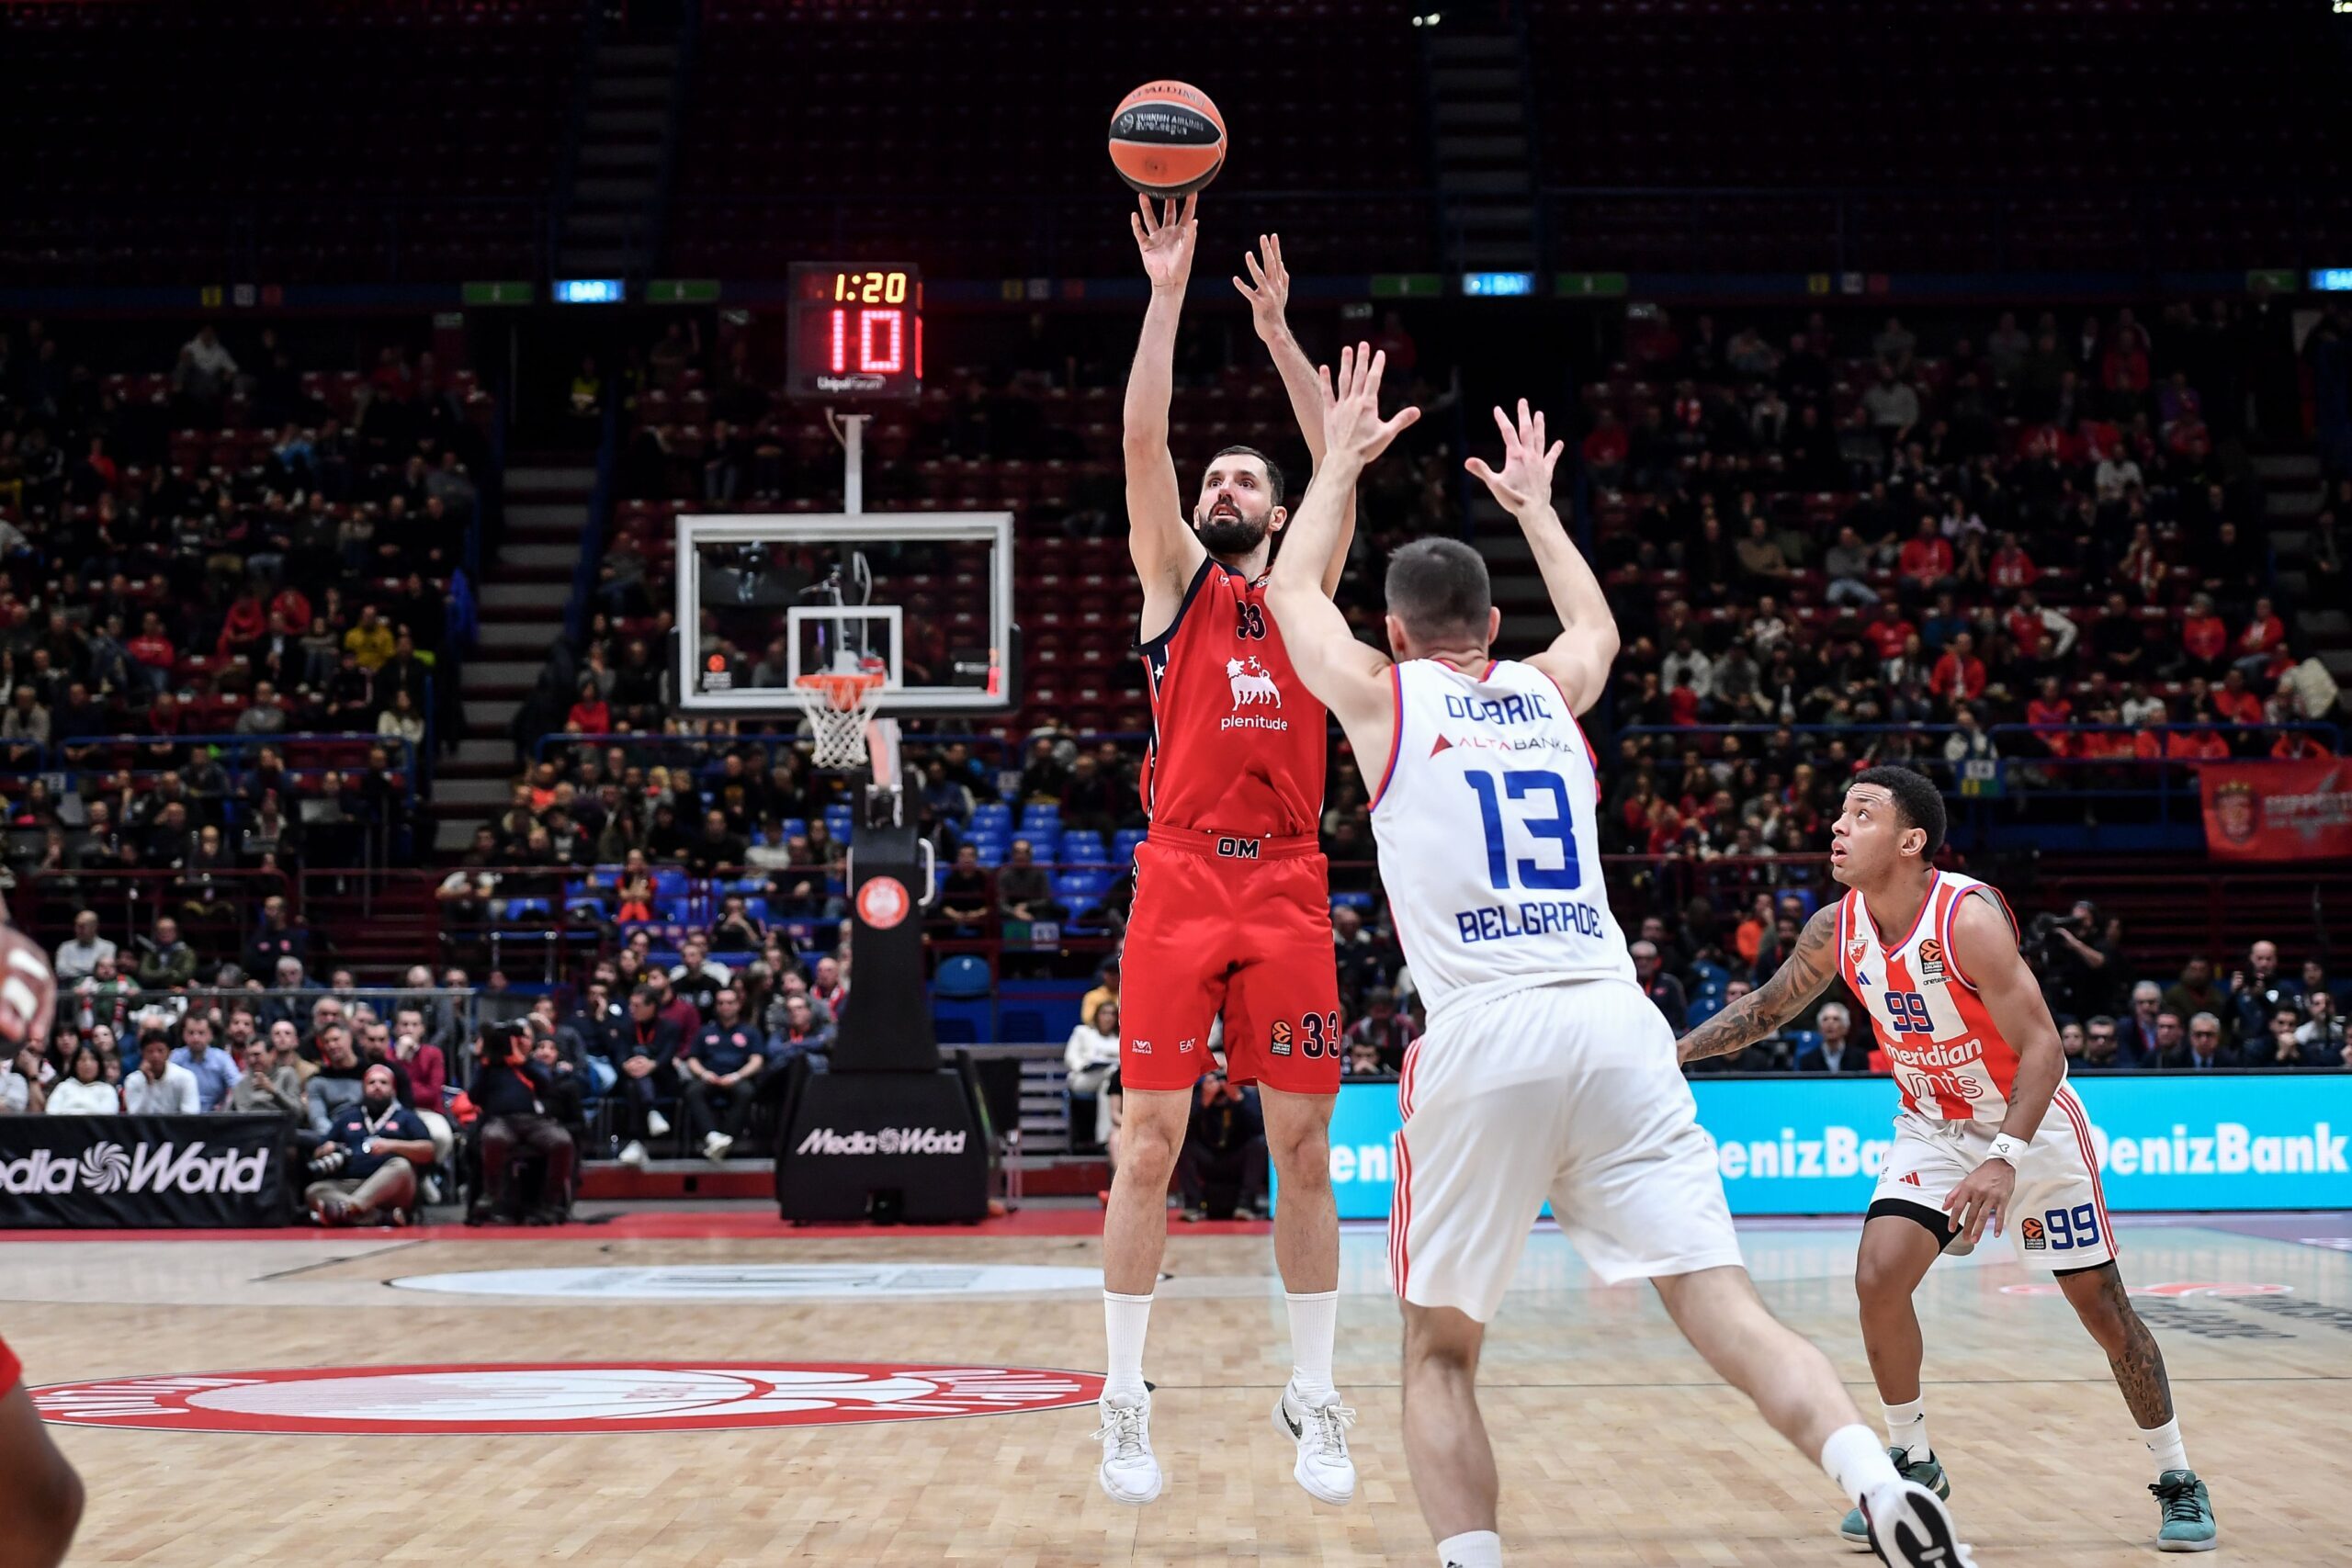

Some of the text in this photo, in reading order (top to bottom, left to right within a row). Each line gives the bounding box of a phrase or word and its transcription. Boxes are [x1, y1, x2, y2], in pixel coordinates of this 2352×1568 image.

[835, 272, 907, 303] 1:20
[832, 310, 902, 373] 10
[1220, 715, 1288, 731] plenitude
[1216, 837, 1260, 859] OM
[1464, 770, 1582, 891] 13
[1455, 901, 1604, 944] BELGRADE
[1883, 990, 1936, 1033] 99
[1301, 1010, 1340, 1059] 33
[1883, 1038, 1984, 1066] meridian
[1906, 1070, 1984, 1100] mts
[797, 1127, 967, 1155] Media World
[1719, 1125, 1894, 1179] enizBa
[0, 1141, 270, 1194] dia World
[2044, 1202, 2100, 1250] 99
